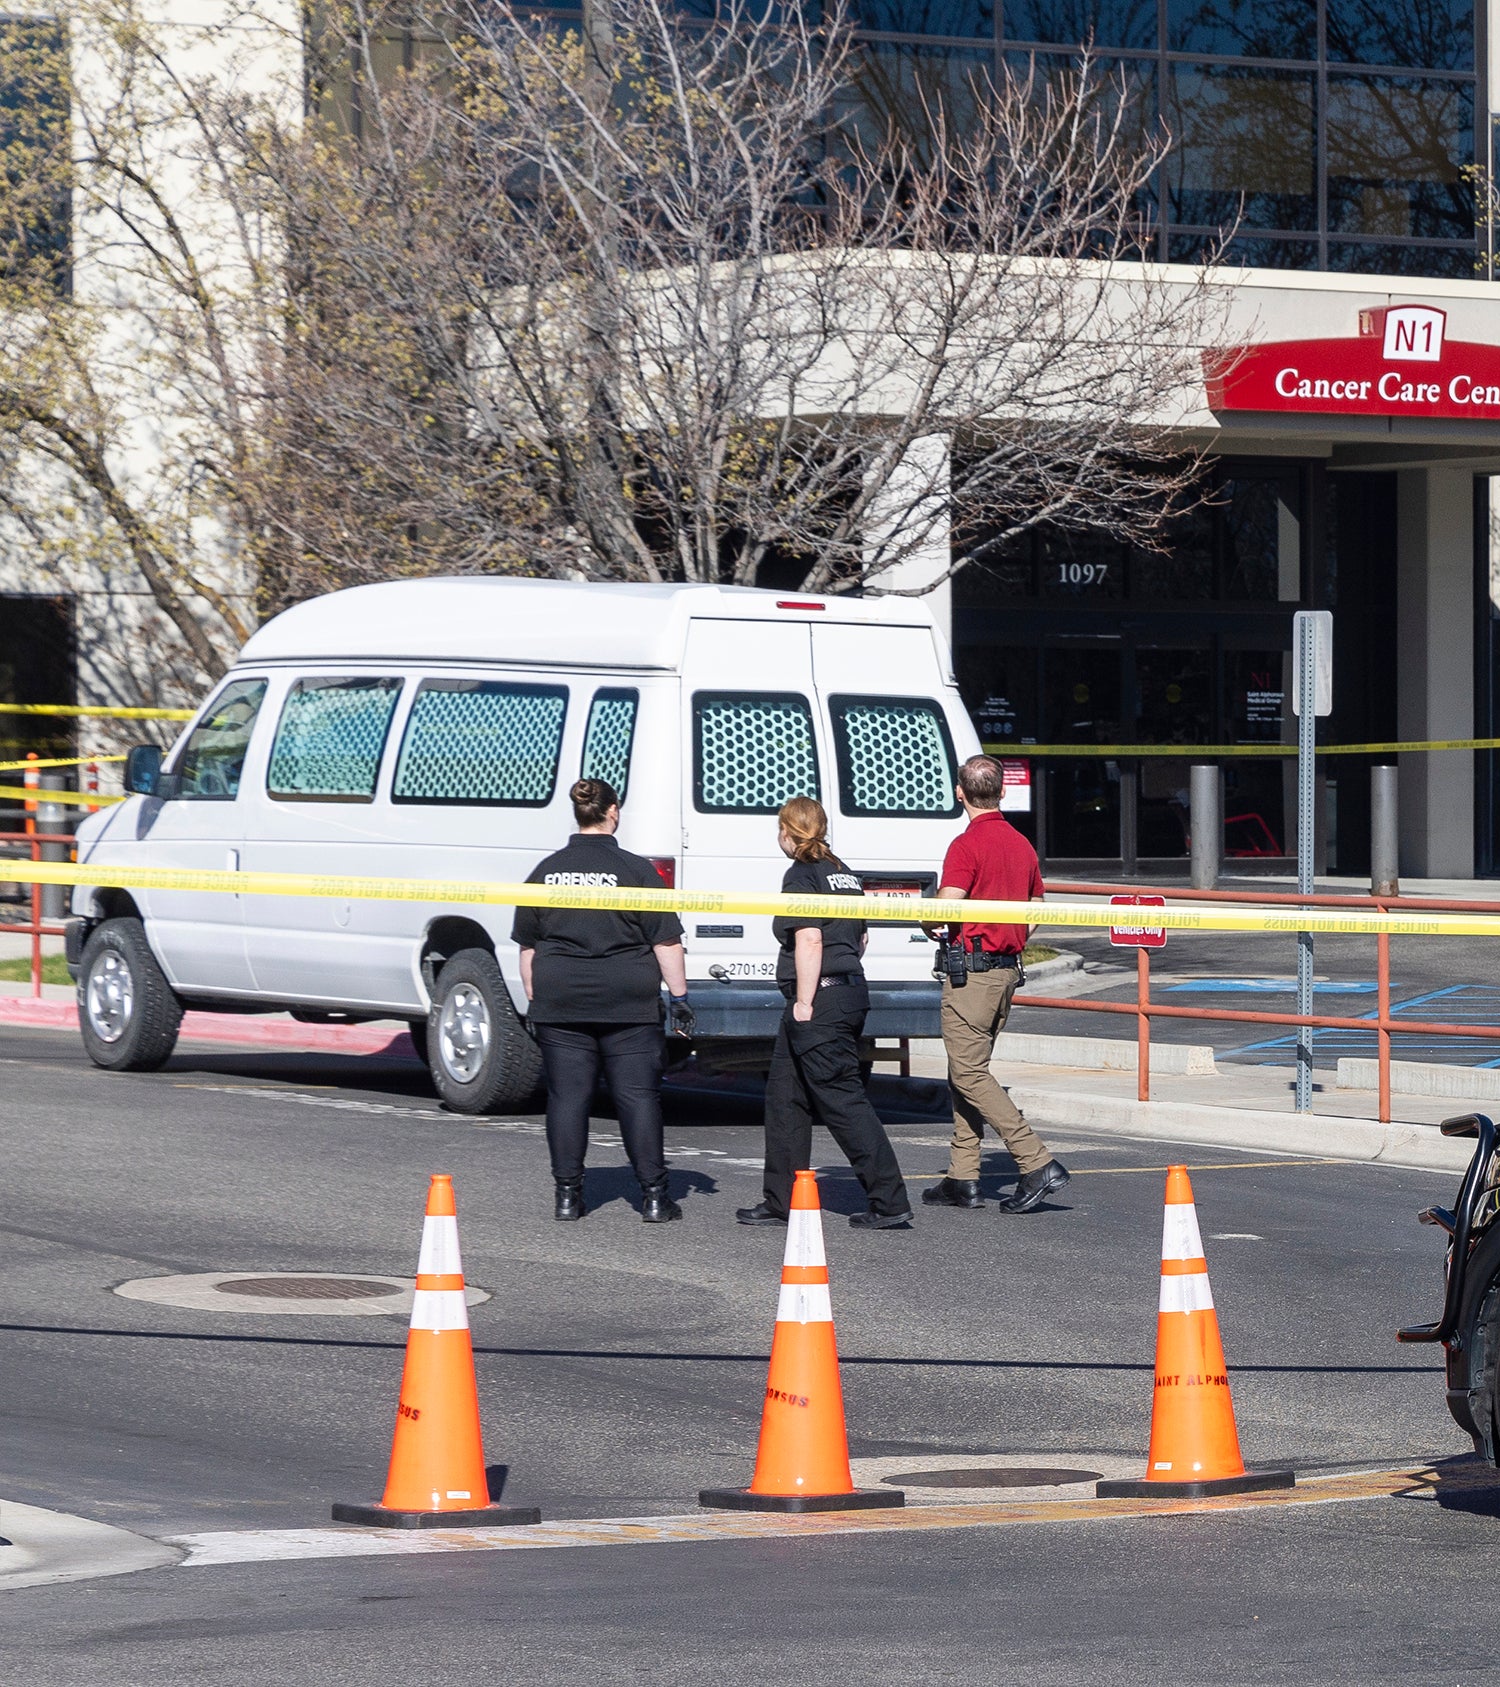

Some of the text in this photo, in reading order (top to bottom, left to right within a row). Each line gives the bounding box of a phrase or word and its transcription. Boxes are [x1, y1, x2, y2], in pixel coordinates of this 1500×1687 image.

[1395, 320, 1431, 353] N1
[1275, 367, 1371, 400] Cancer
[1378, 371, 1440, 403] Care
[1059, 563, 1108, 585] 1097
[544, 872, 617, 887] FORENSICS
